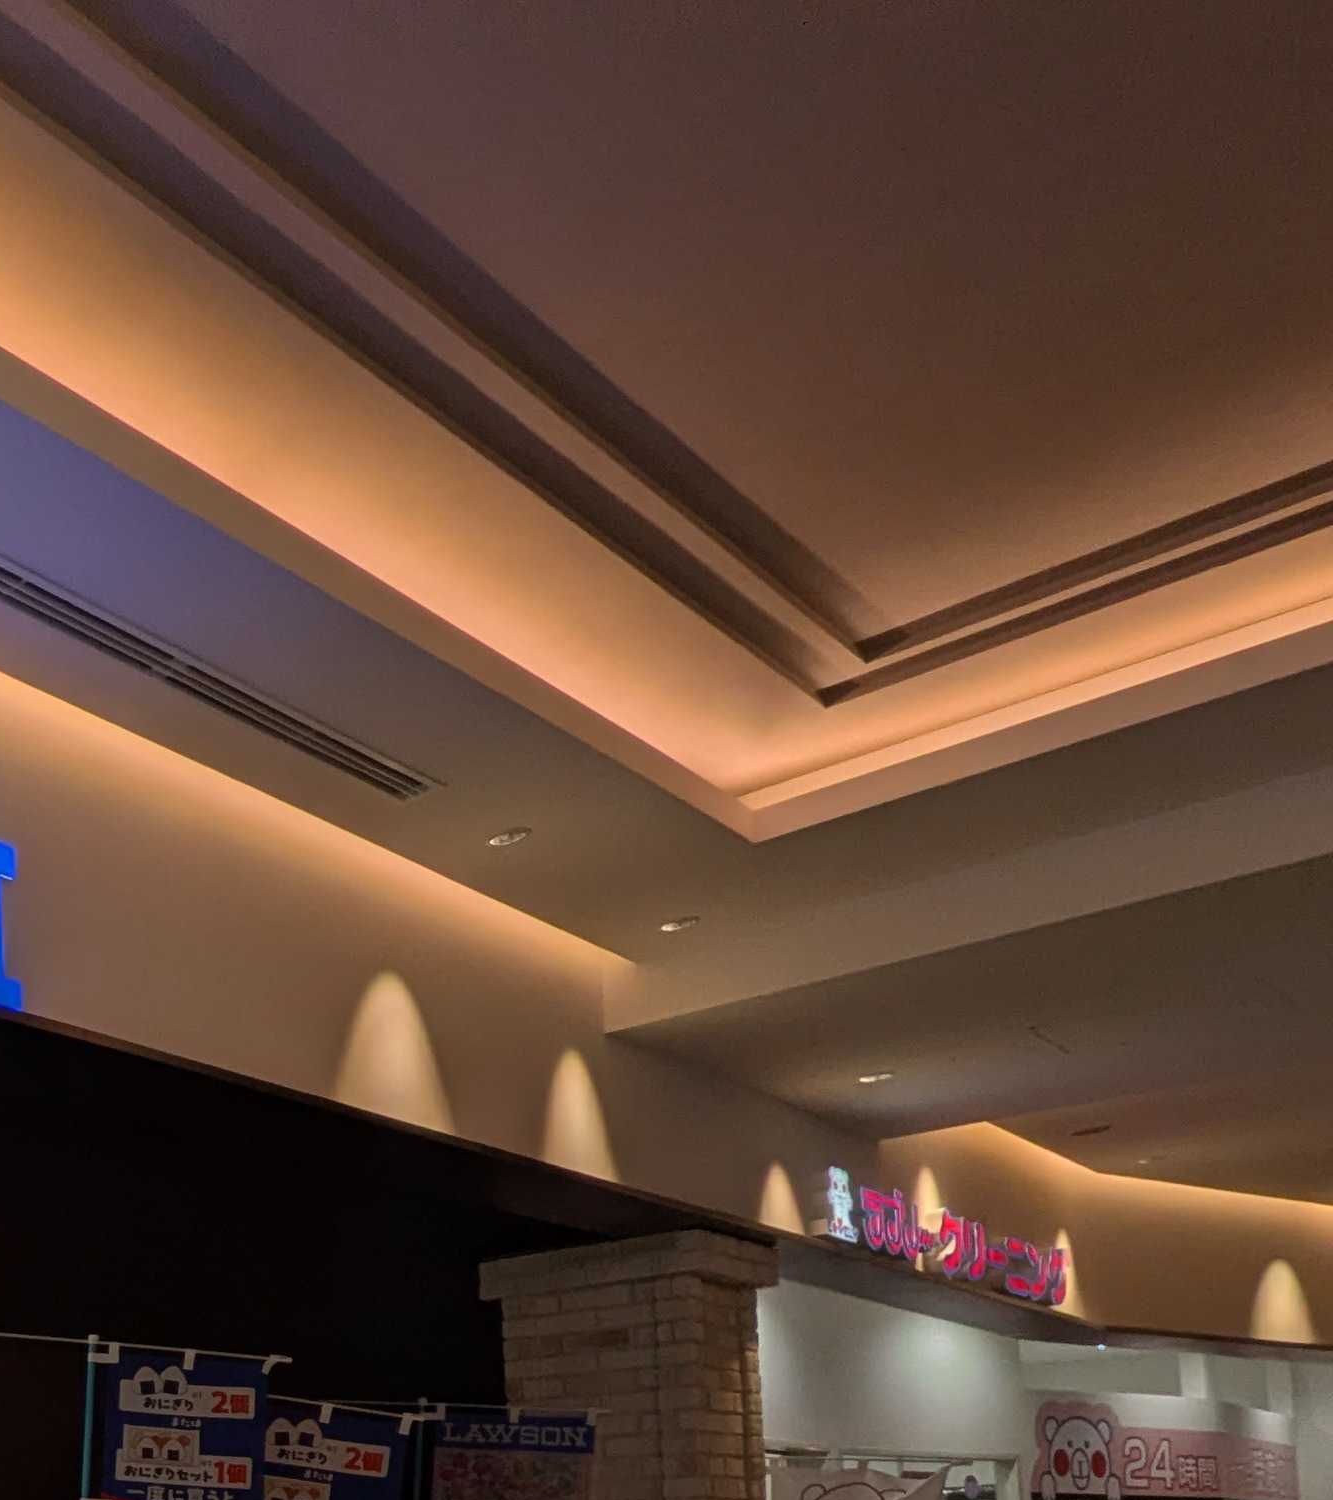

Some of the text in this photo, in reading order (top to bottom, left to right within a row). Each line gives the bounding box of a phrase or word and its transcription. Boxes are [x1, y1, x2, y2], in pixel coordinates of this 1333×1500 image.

[143, 1391, 250, 1414] おにぎり 2個
[443, 1422, 587, 1448] LAWSON
[277, 1448, 328, 1465] おにぎり
[124, 1466, 214, 1481] おにぎりセット
